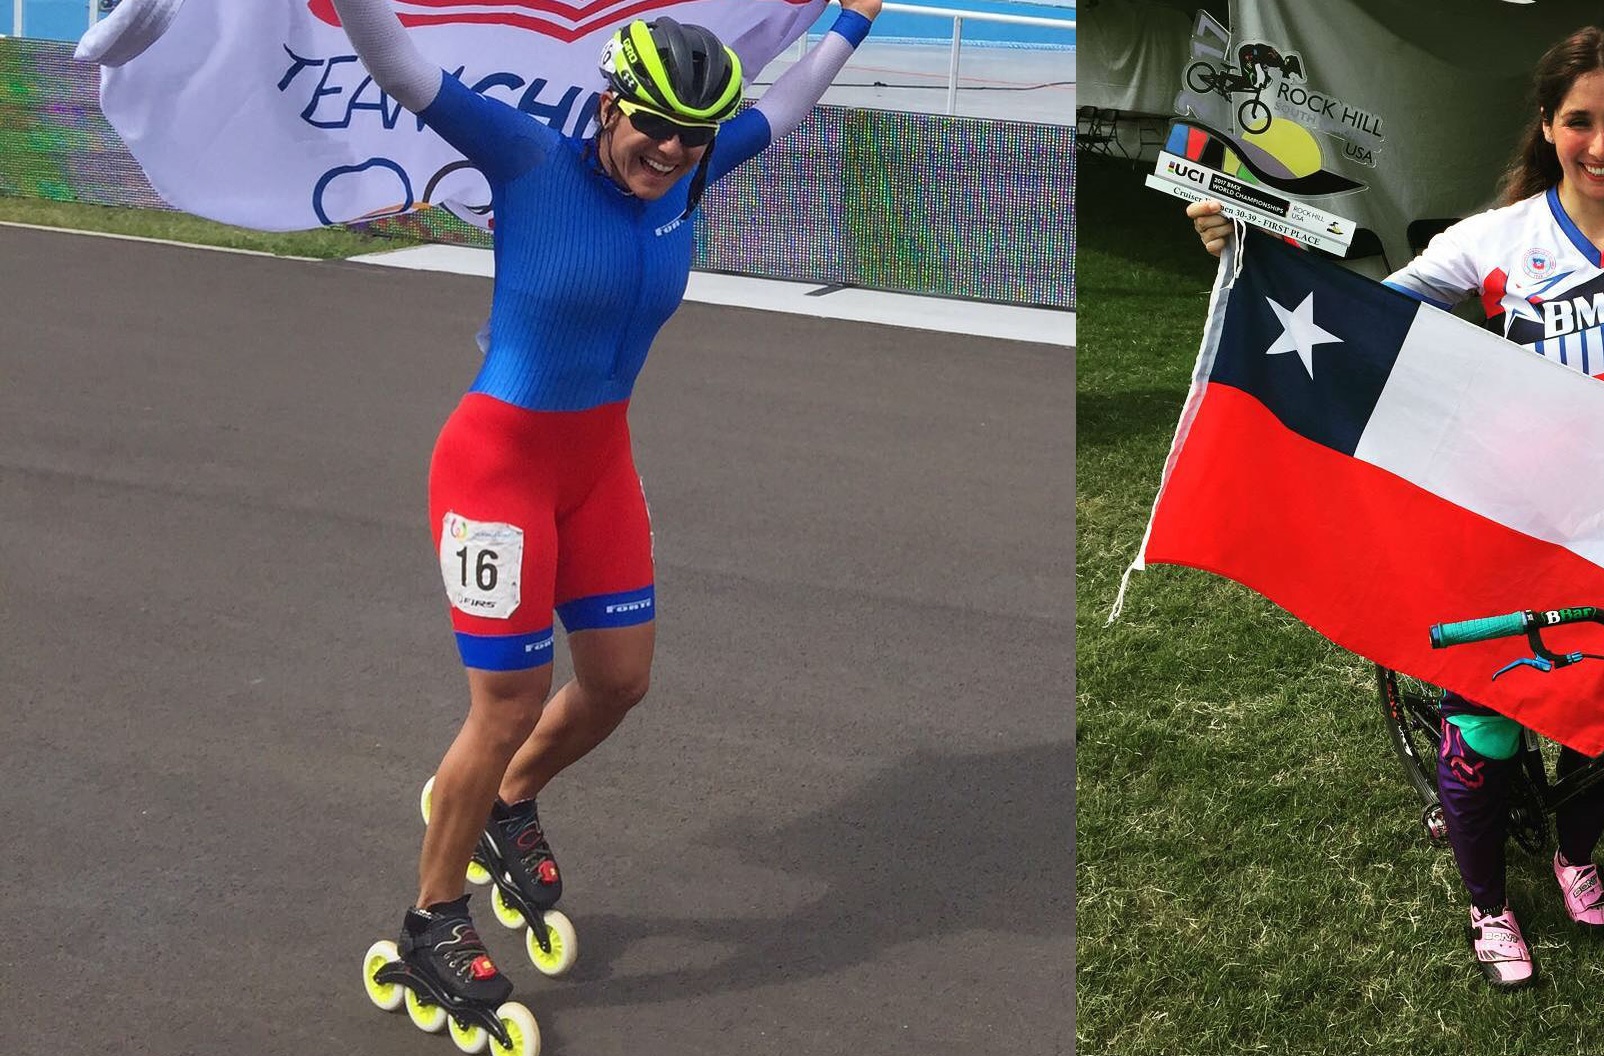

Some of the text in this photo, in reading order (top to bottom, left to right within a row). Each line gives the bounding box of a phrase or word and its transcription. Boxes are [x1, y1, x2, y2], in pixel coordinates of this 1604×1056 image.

[1277, 82, 1337, 119] ROCK
[1341, 107, 1381, 137] HILL
[1346, 142, 1373, 163] USA
[1174, 163, 1205, 184] UCI
[1213, 177, 1242, 191] 2017 BMX
[1212, 184, 1284, 214] WORLD CHAMPIONSHIPS
[1173, 187, 1203, 203] Cruiser
[1234, 209, 1257, 222] 30-39
[1263, 220, 1289, 236] FIRST
[1290, 229, 1321, 247] PLACE
[1292, 213, 1304, 222] USA
[1293, 206, 1309, 218] ROCK
[456, 546, 499, 591] 16
